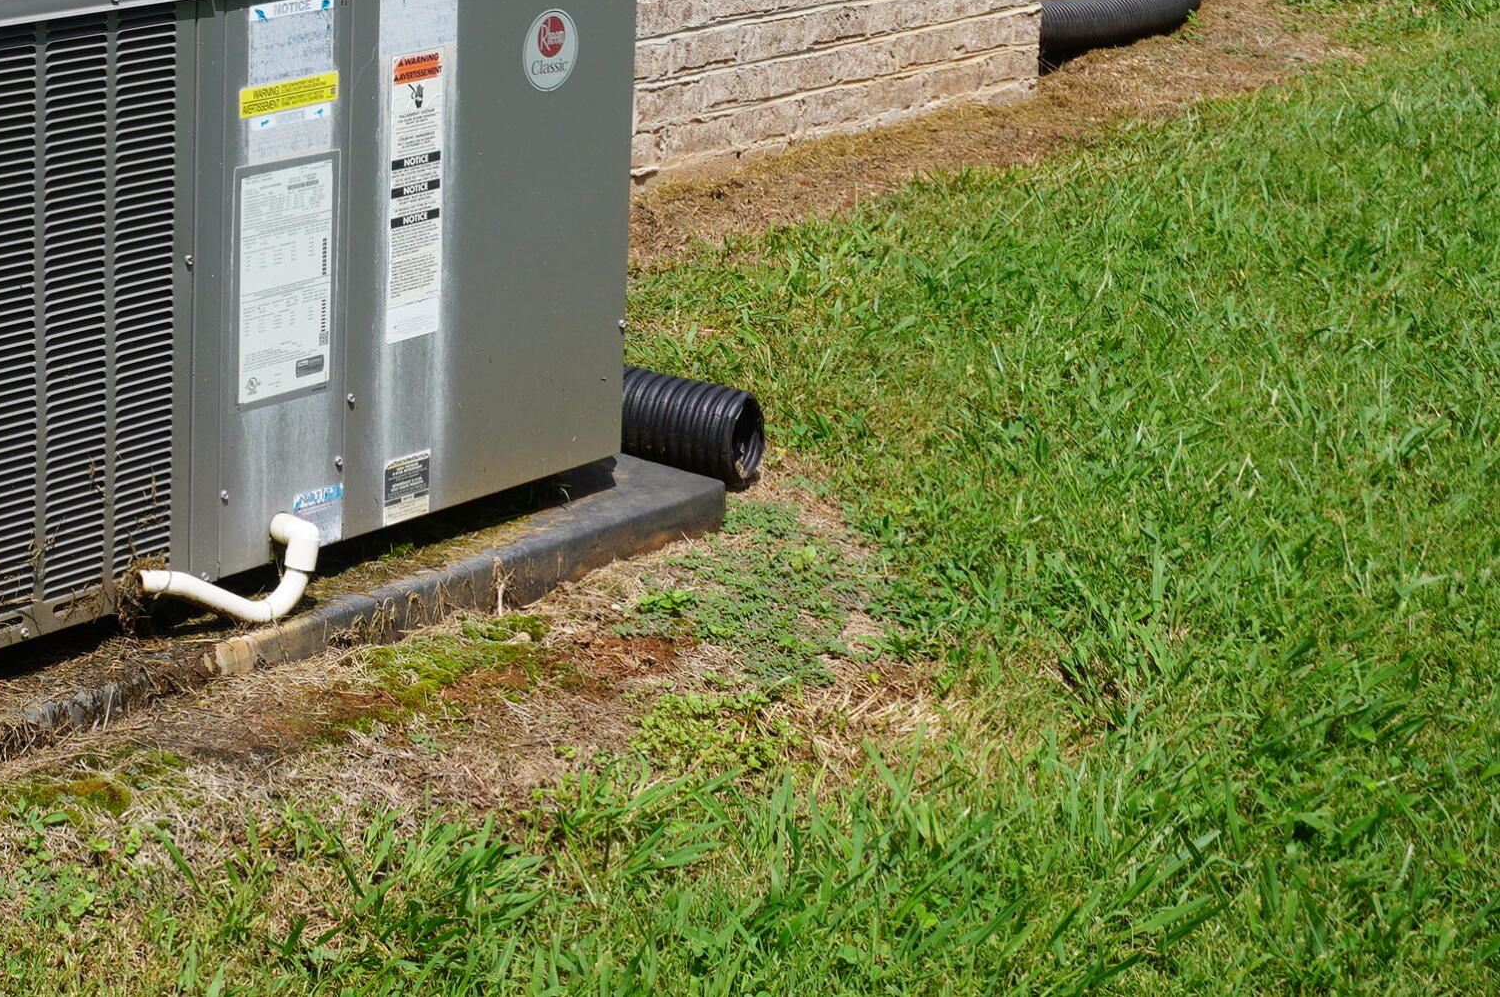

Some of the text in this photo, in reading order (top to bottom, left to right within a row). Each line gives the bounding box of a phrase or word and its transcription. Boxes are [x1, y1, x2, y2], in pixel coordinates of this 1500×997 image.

[274, 0, 312, 16] NOTICE
[404, 52, 439, 66] WARNING
[400, 65, 442, 80] AVERTISSEMENT
[531, 58, 569, 76] Classic
[403, 154, 429, 167] NOTICE
[403, 182, 429, 195] NOTICE
[402, 211, 428, 225] NOTICE
